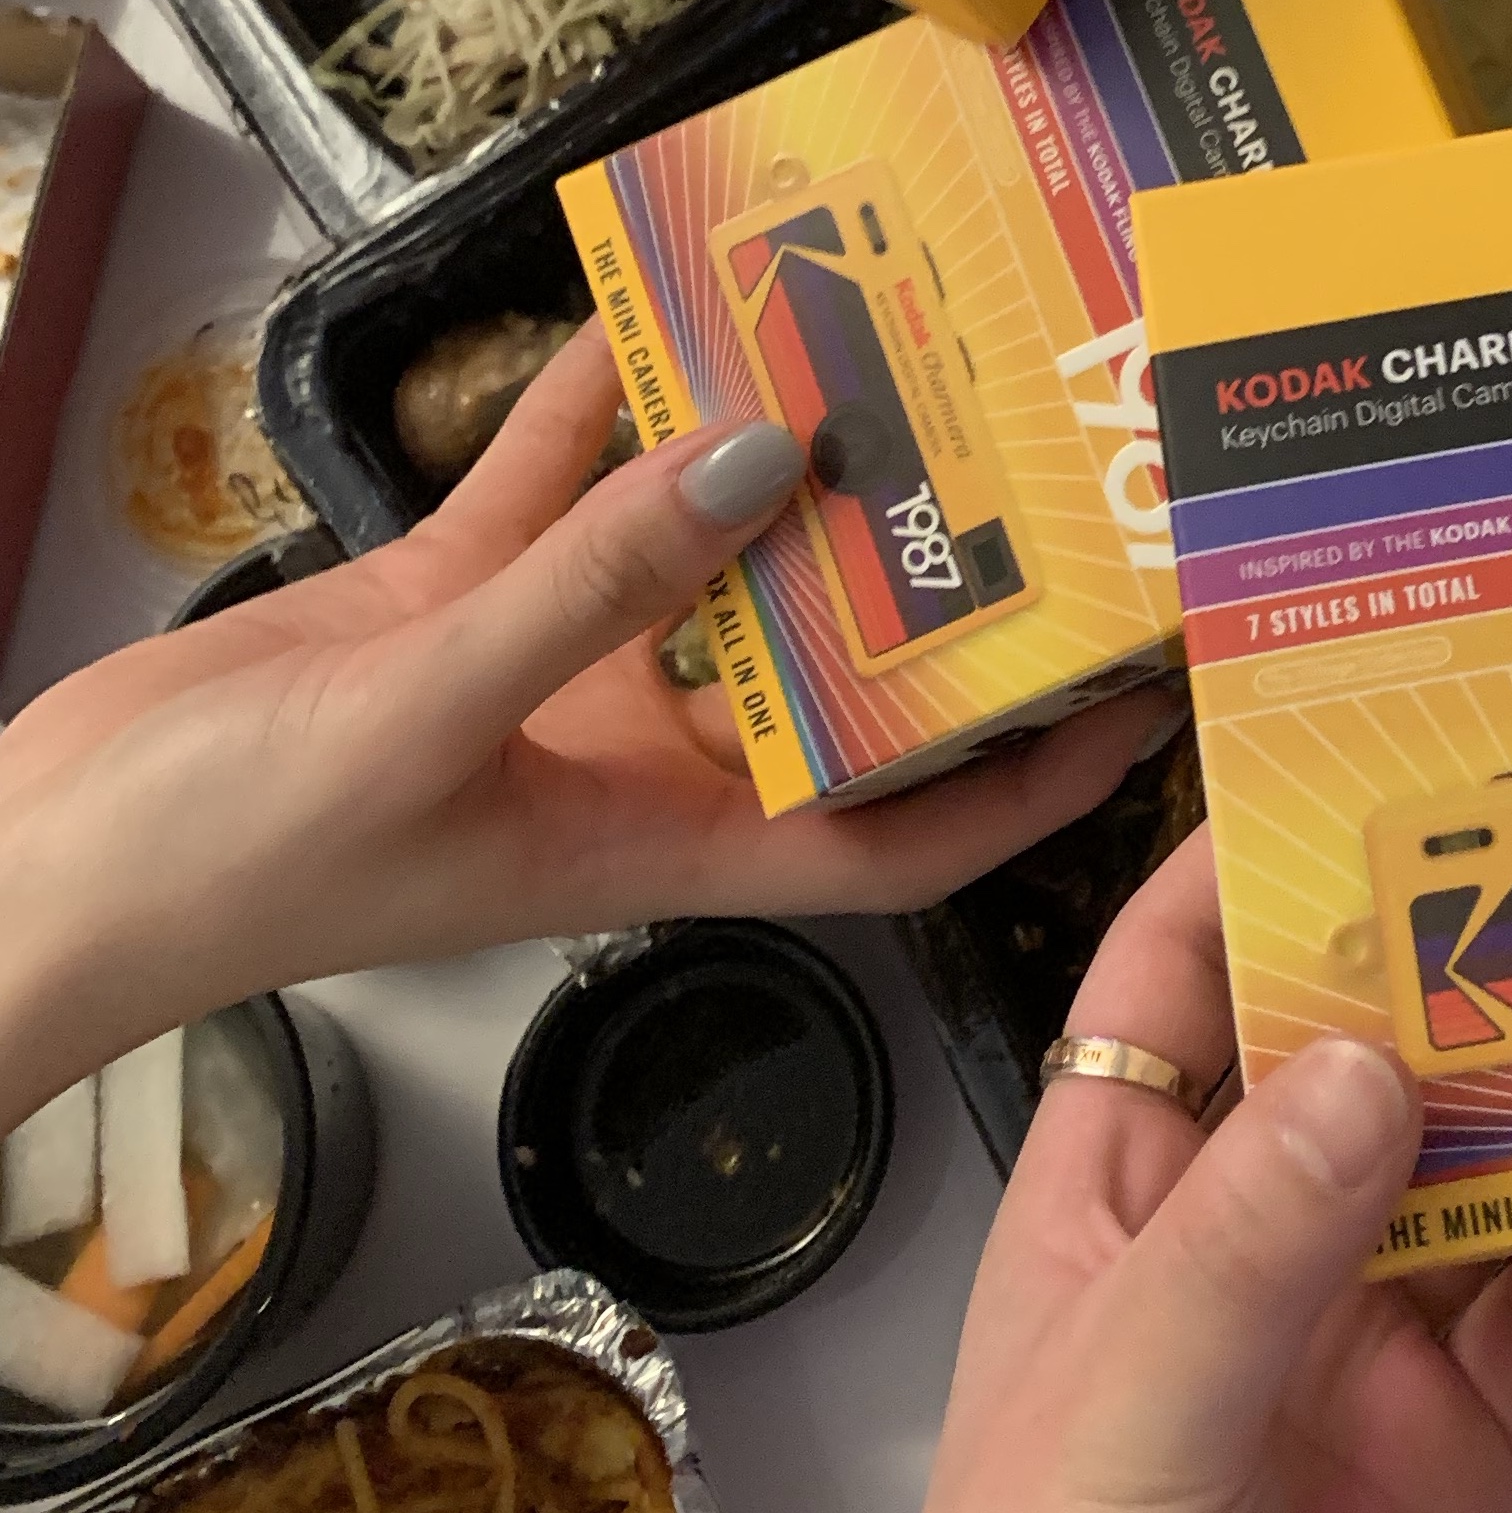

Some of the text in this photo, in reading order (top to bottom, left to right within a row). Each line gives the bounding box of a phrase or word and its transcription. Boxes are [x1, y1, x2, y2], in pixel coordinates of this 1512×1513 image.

[1025, 111, 1049, 135] IN
[1036, 134, 1070, 198] TOTAL
[1087, 141, 1122, 209] KODAK
[591, 237, 622, 285] THE
[607, 286, 642, 343] MINI
[1215, 356, 1372, 414] KODAK
[1221, 408, 1348, 450] Keychain
[1356, 388, 1446, 426] Digital
[885, 480, 963, 589] 1987
[1239, 545, 1343, 581] INSPIRED
[1348, 539, 1377, 563] BY
[1382, 530, 1426, 555] THE
[1429, 516, 1511, 547] KODAK
[713, 609, 746, 654] ALL
[1245, 574, 1482, 640] 7 STYLES IN TOTAL
[731, 656, 758, 687] IN
[742, 689, 777, 744] ONE
[1375, 1212, 1430, 1254] HE
